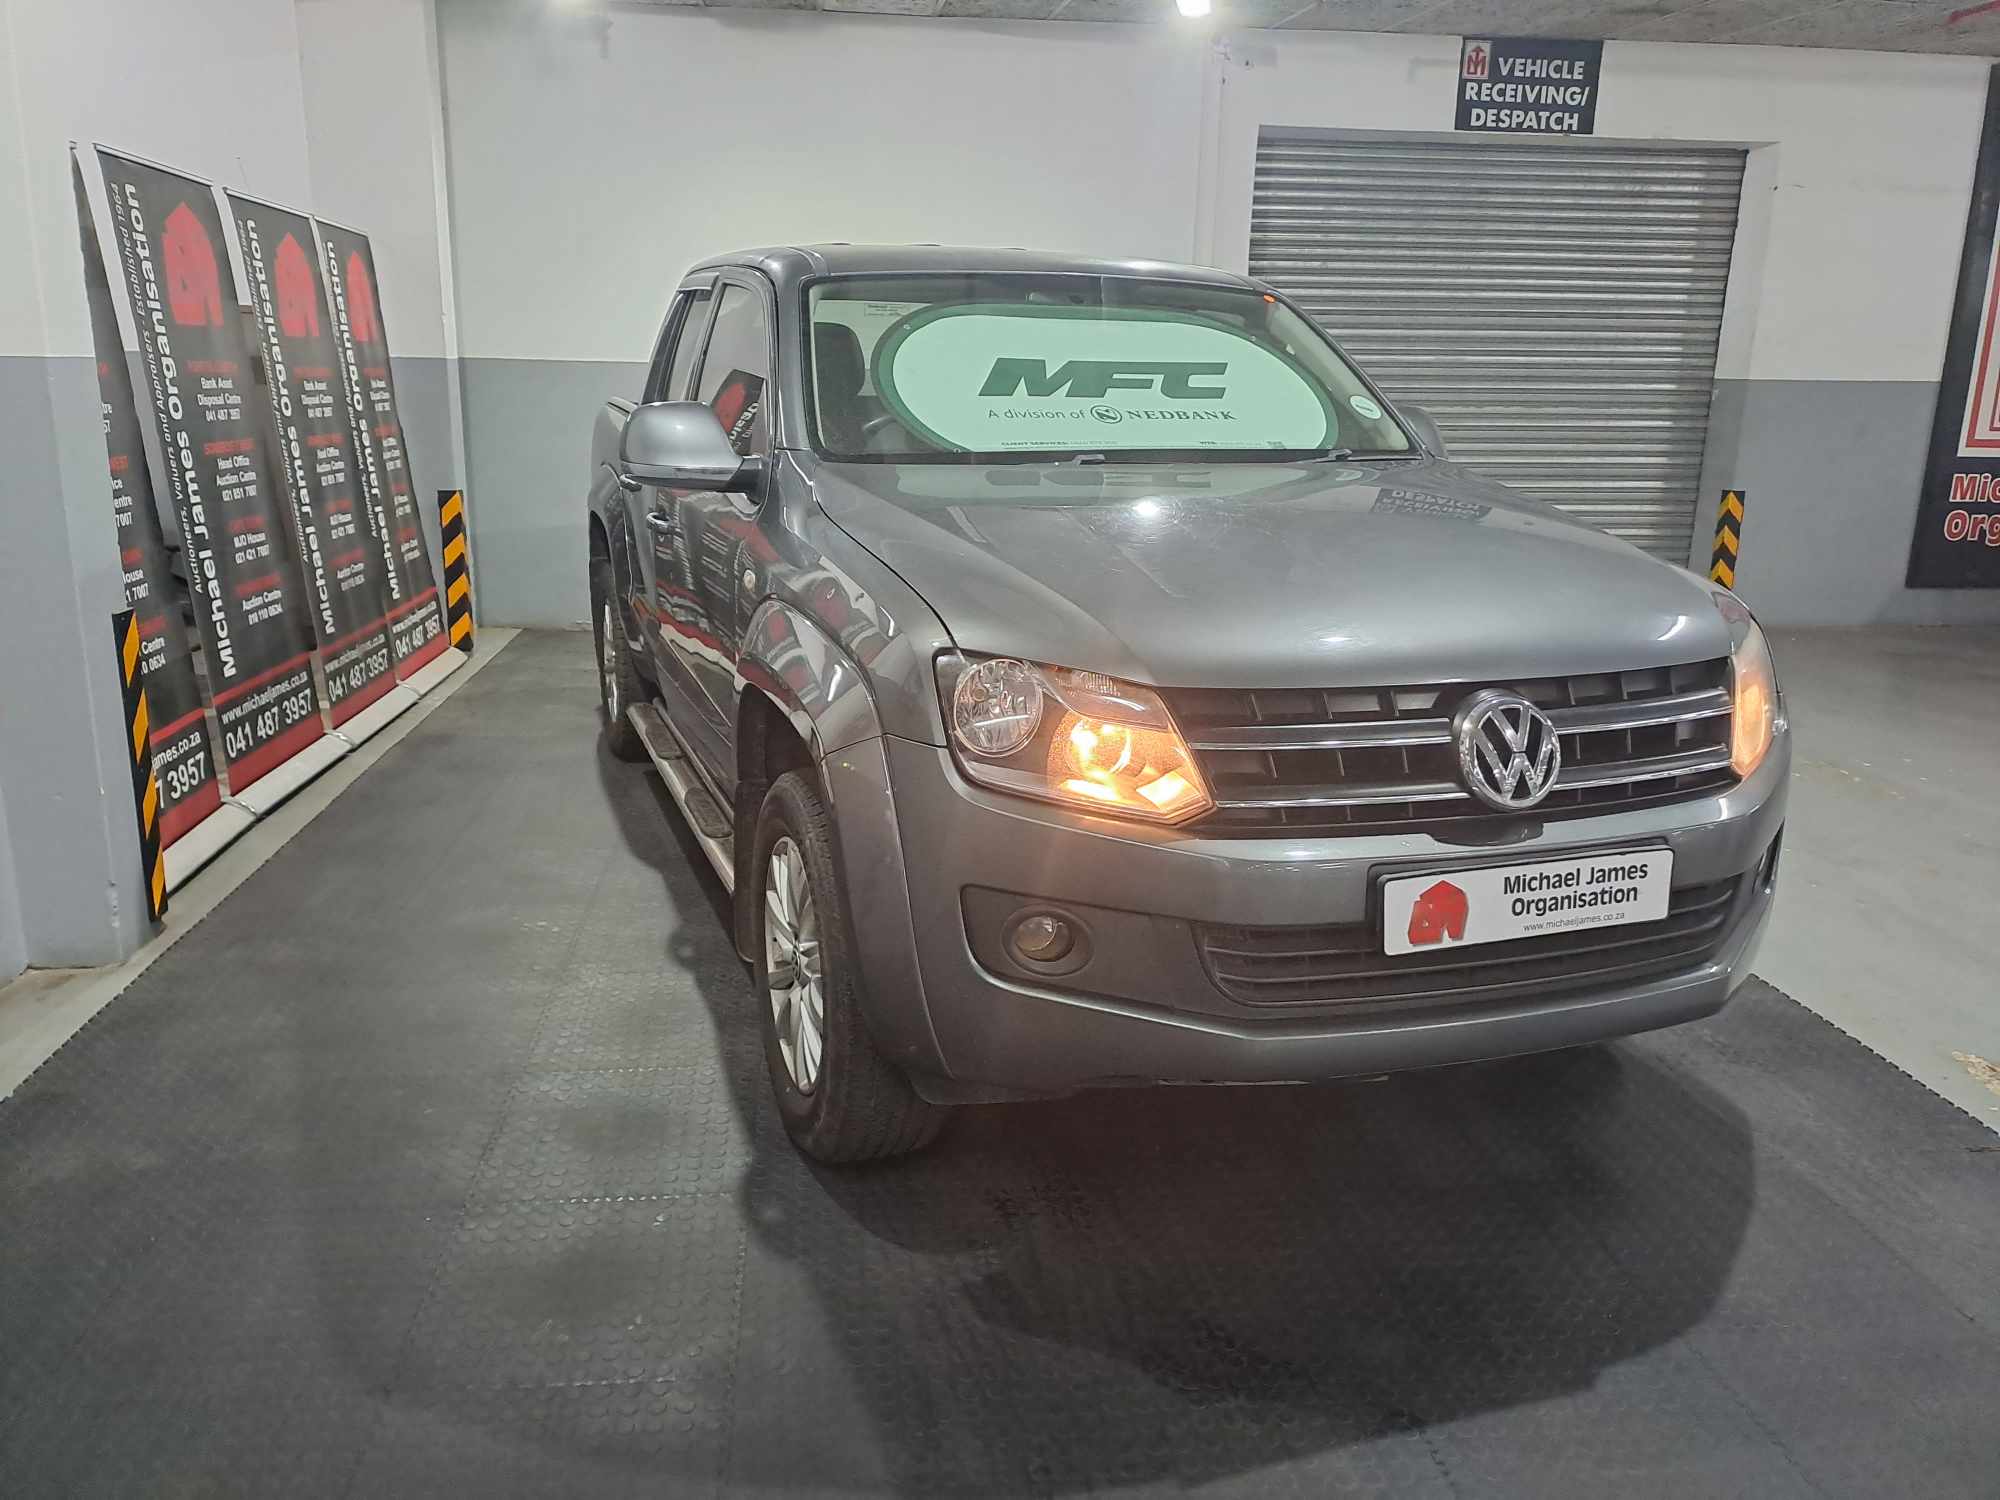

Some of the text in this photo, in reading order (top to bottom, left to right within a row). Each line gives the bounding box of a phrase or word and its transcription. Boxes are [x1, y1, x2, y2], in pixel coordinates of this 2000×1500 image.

[1498, 57, 1585, 79] VEHICLE
[1465, 82, 1591, 106] RECEIVING/
[1470, 108, 1579, 131] DESPATCH
[110, 183, 126, 222] 1964
[119, 225, 145, 316] Established
[327, 241, 363, 411] Organisation
[143, 330, 166, 410] Appraisers
[978, 357, 1228, 399] MFC
[125, 183, 237, 678] Michael James Organisation
[158, 413, 171, 442] and
[246, 219, 336, 635] Michael James Organisation
[988, 408, 1239, 421] A division of NEDBANK
[167, 447, 183, 500] Valuers
[359, 419, 381, 498] James
[181, 506, 204, 593] Auctioneers,
[374, 505, 400, 600] Michael
[328, 647, 389, 702] 041 487 3957
[225, 687, 312, 758] 041 487 3957
[167, 751, 206, 799] 3957
[1503, 863, 1648, 895] Michael James
[1511, 886, 1638, 917] Organisation
[1522, 912, 1625, 932] www.michaeljames.co.za
